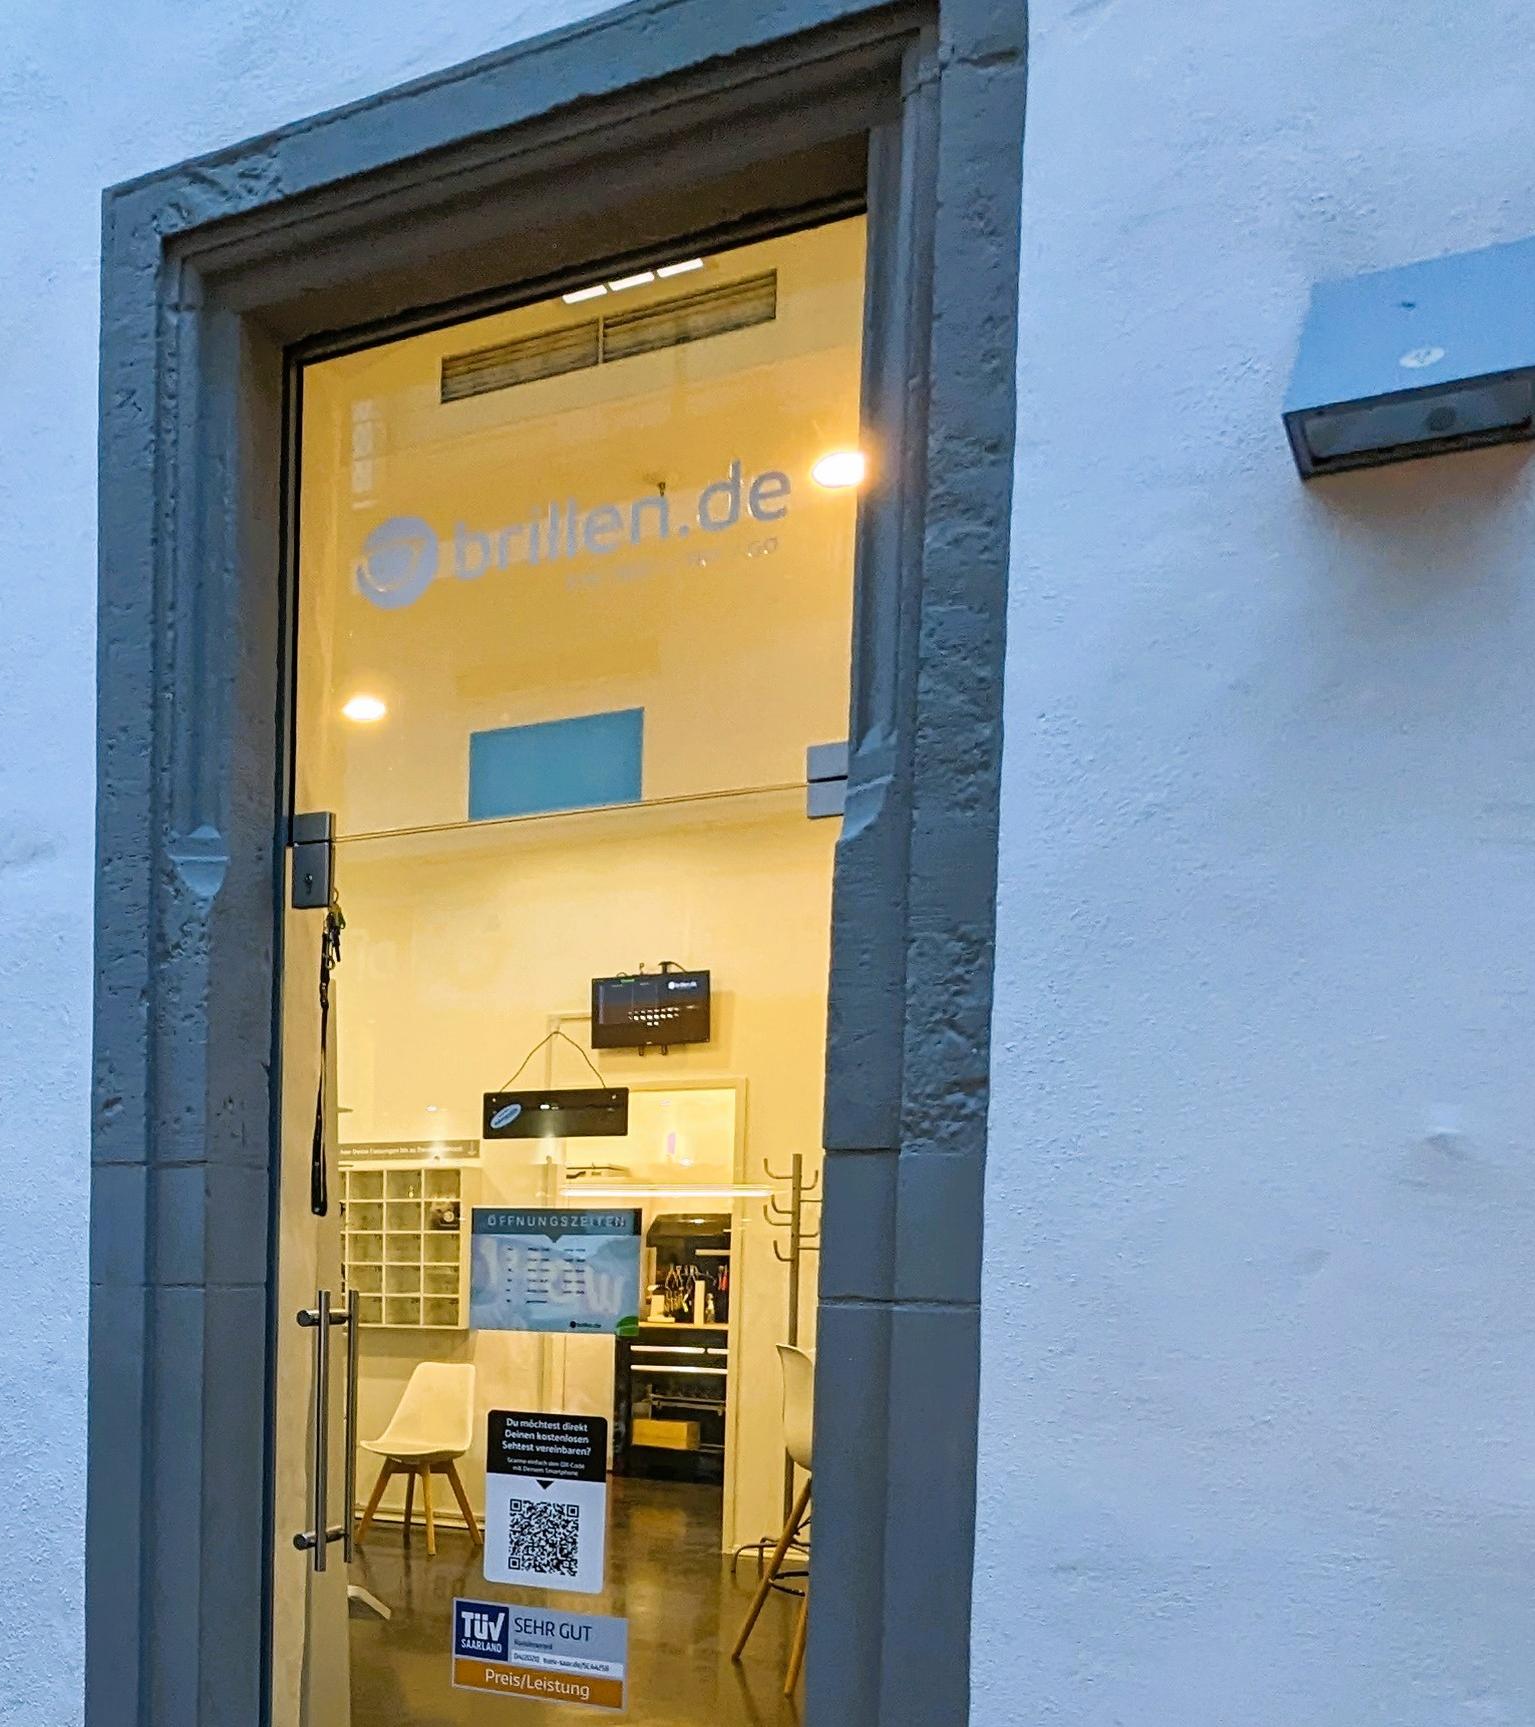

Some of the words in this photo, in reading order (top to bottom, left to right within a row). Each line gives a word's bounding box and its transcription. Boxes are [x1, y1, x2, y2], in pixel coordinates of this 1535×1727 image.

[453, 459, 792, 583] brillen.de
[487, 1214, 626, 1228] ÖFFNUNGSZEITEN
[506, 1418, 519, 1427] Du
[520, 1419, 561, 1431] möchtest
[562, 1422, 588, 1432] direkt
[505, 1430, 535, 1440] Deinen
[536, 1432, 590, 1444] kostenlosen
[502, 1440, 534, 1452] Sehtest
[535, 1443, 592, 1456] vereinbaren?
[461, 1611, 506, 1642] TÜV
[514, 1617, 555, 1637] SEHR
[559, 1622, 592, 1642] GUT
[460, 1639, 503, 1653] SAARLAND
[485, 1668, 590, 1700] Preis/Leistung
